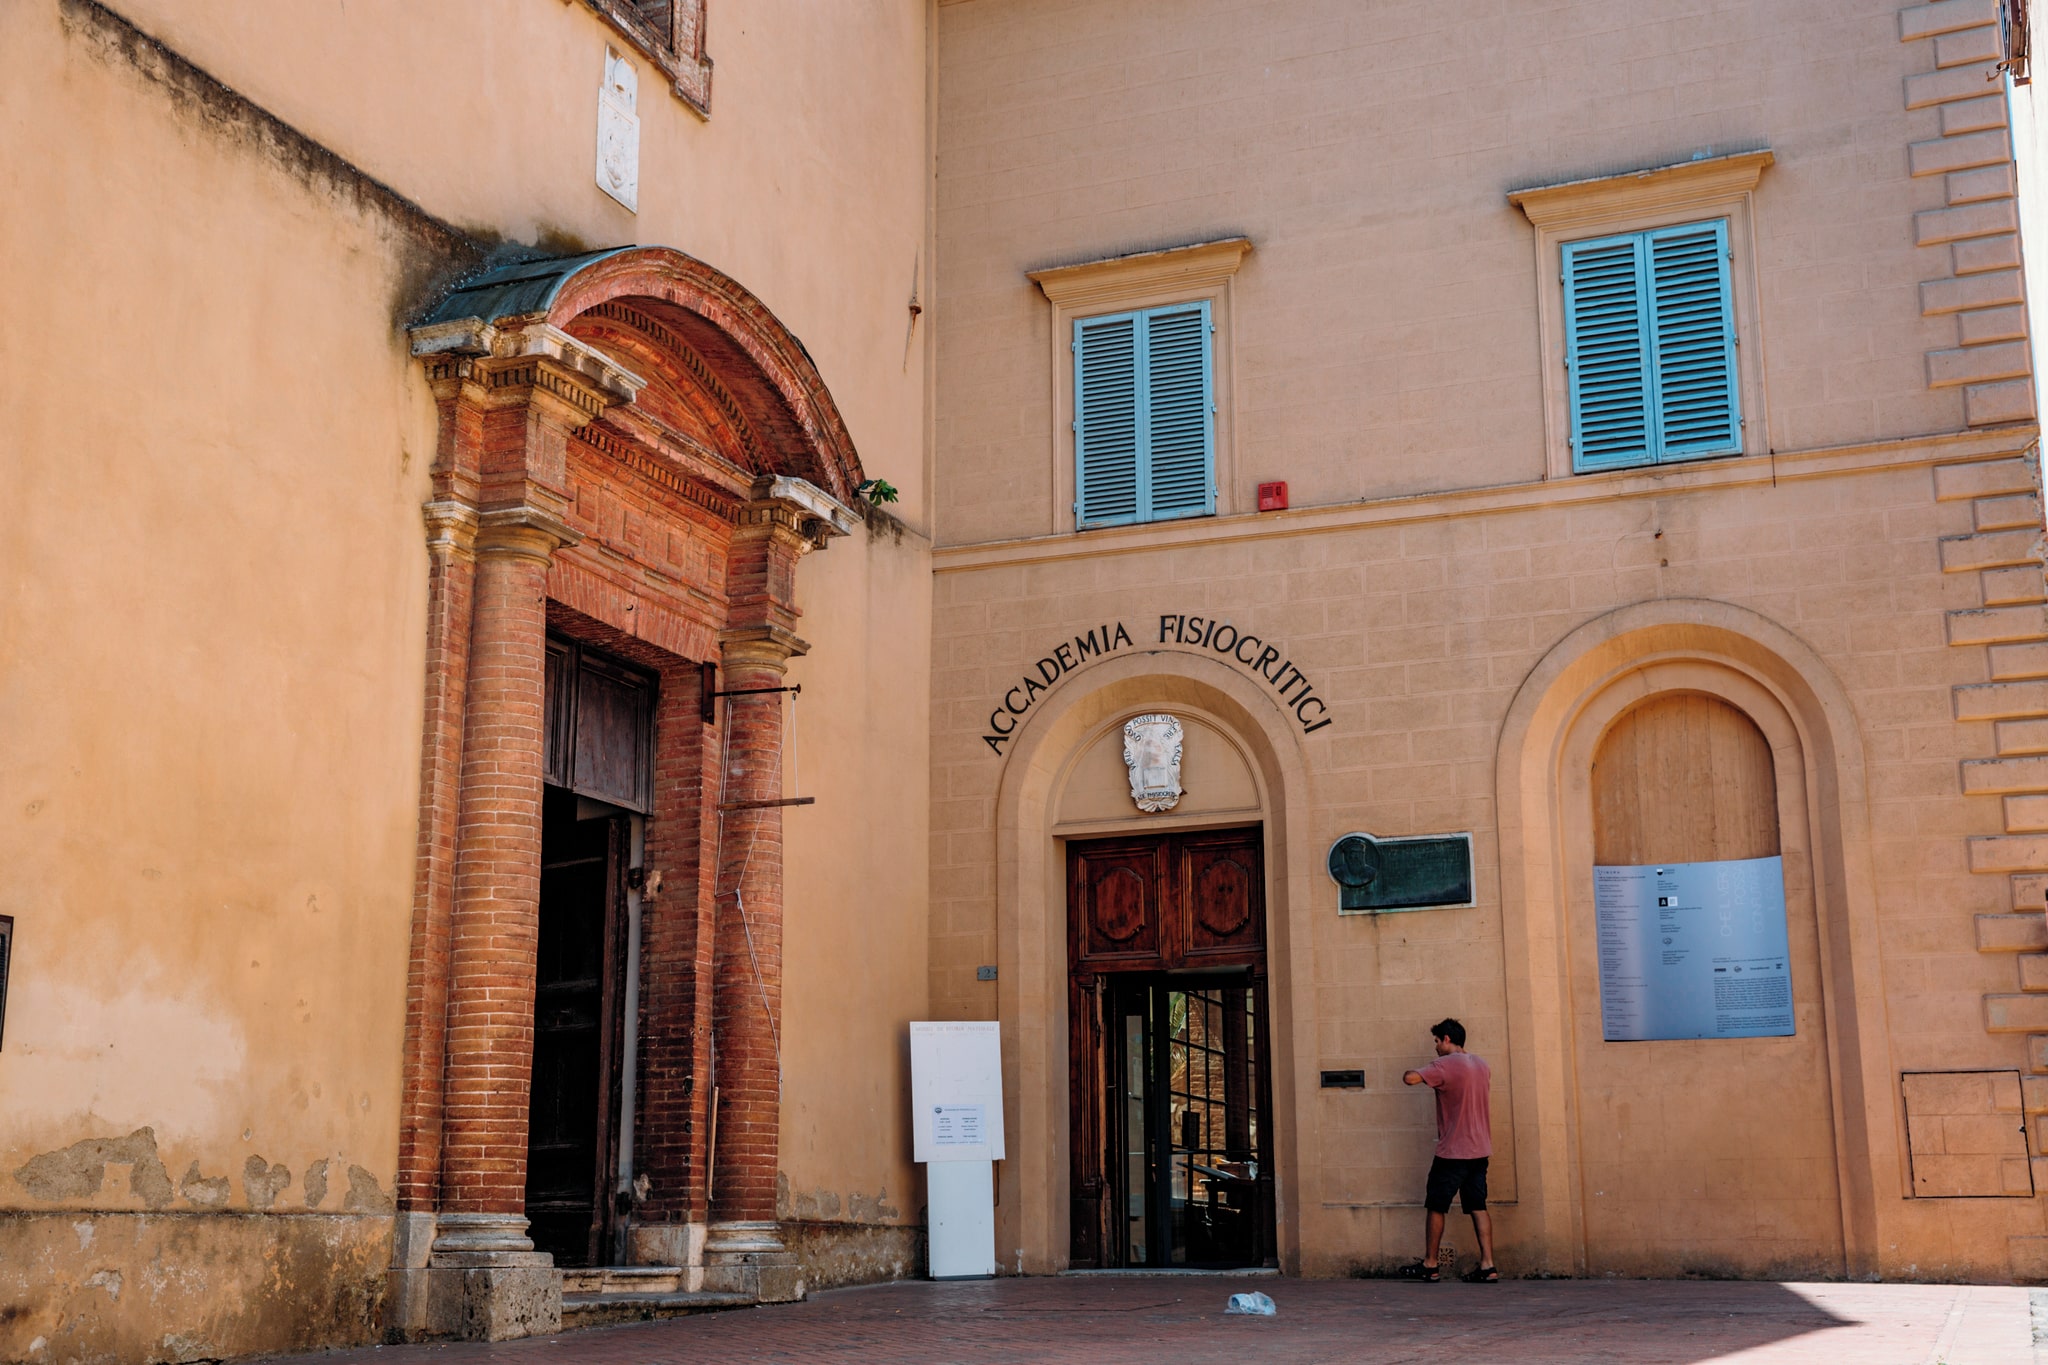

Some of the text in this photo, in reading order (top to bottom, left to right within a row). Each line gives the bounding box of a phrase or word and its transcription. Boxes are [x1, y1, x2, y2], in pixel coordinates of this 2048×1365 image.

[982, 615, 1332, 756] ACCADEMIA FISIOCRITICI
[1133, 715, 1157, 726] POSSIT
[984, 968, 991, 978] 2
